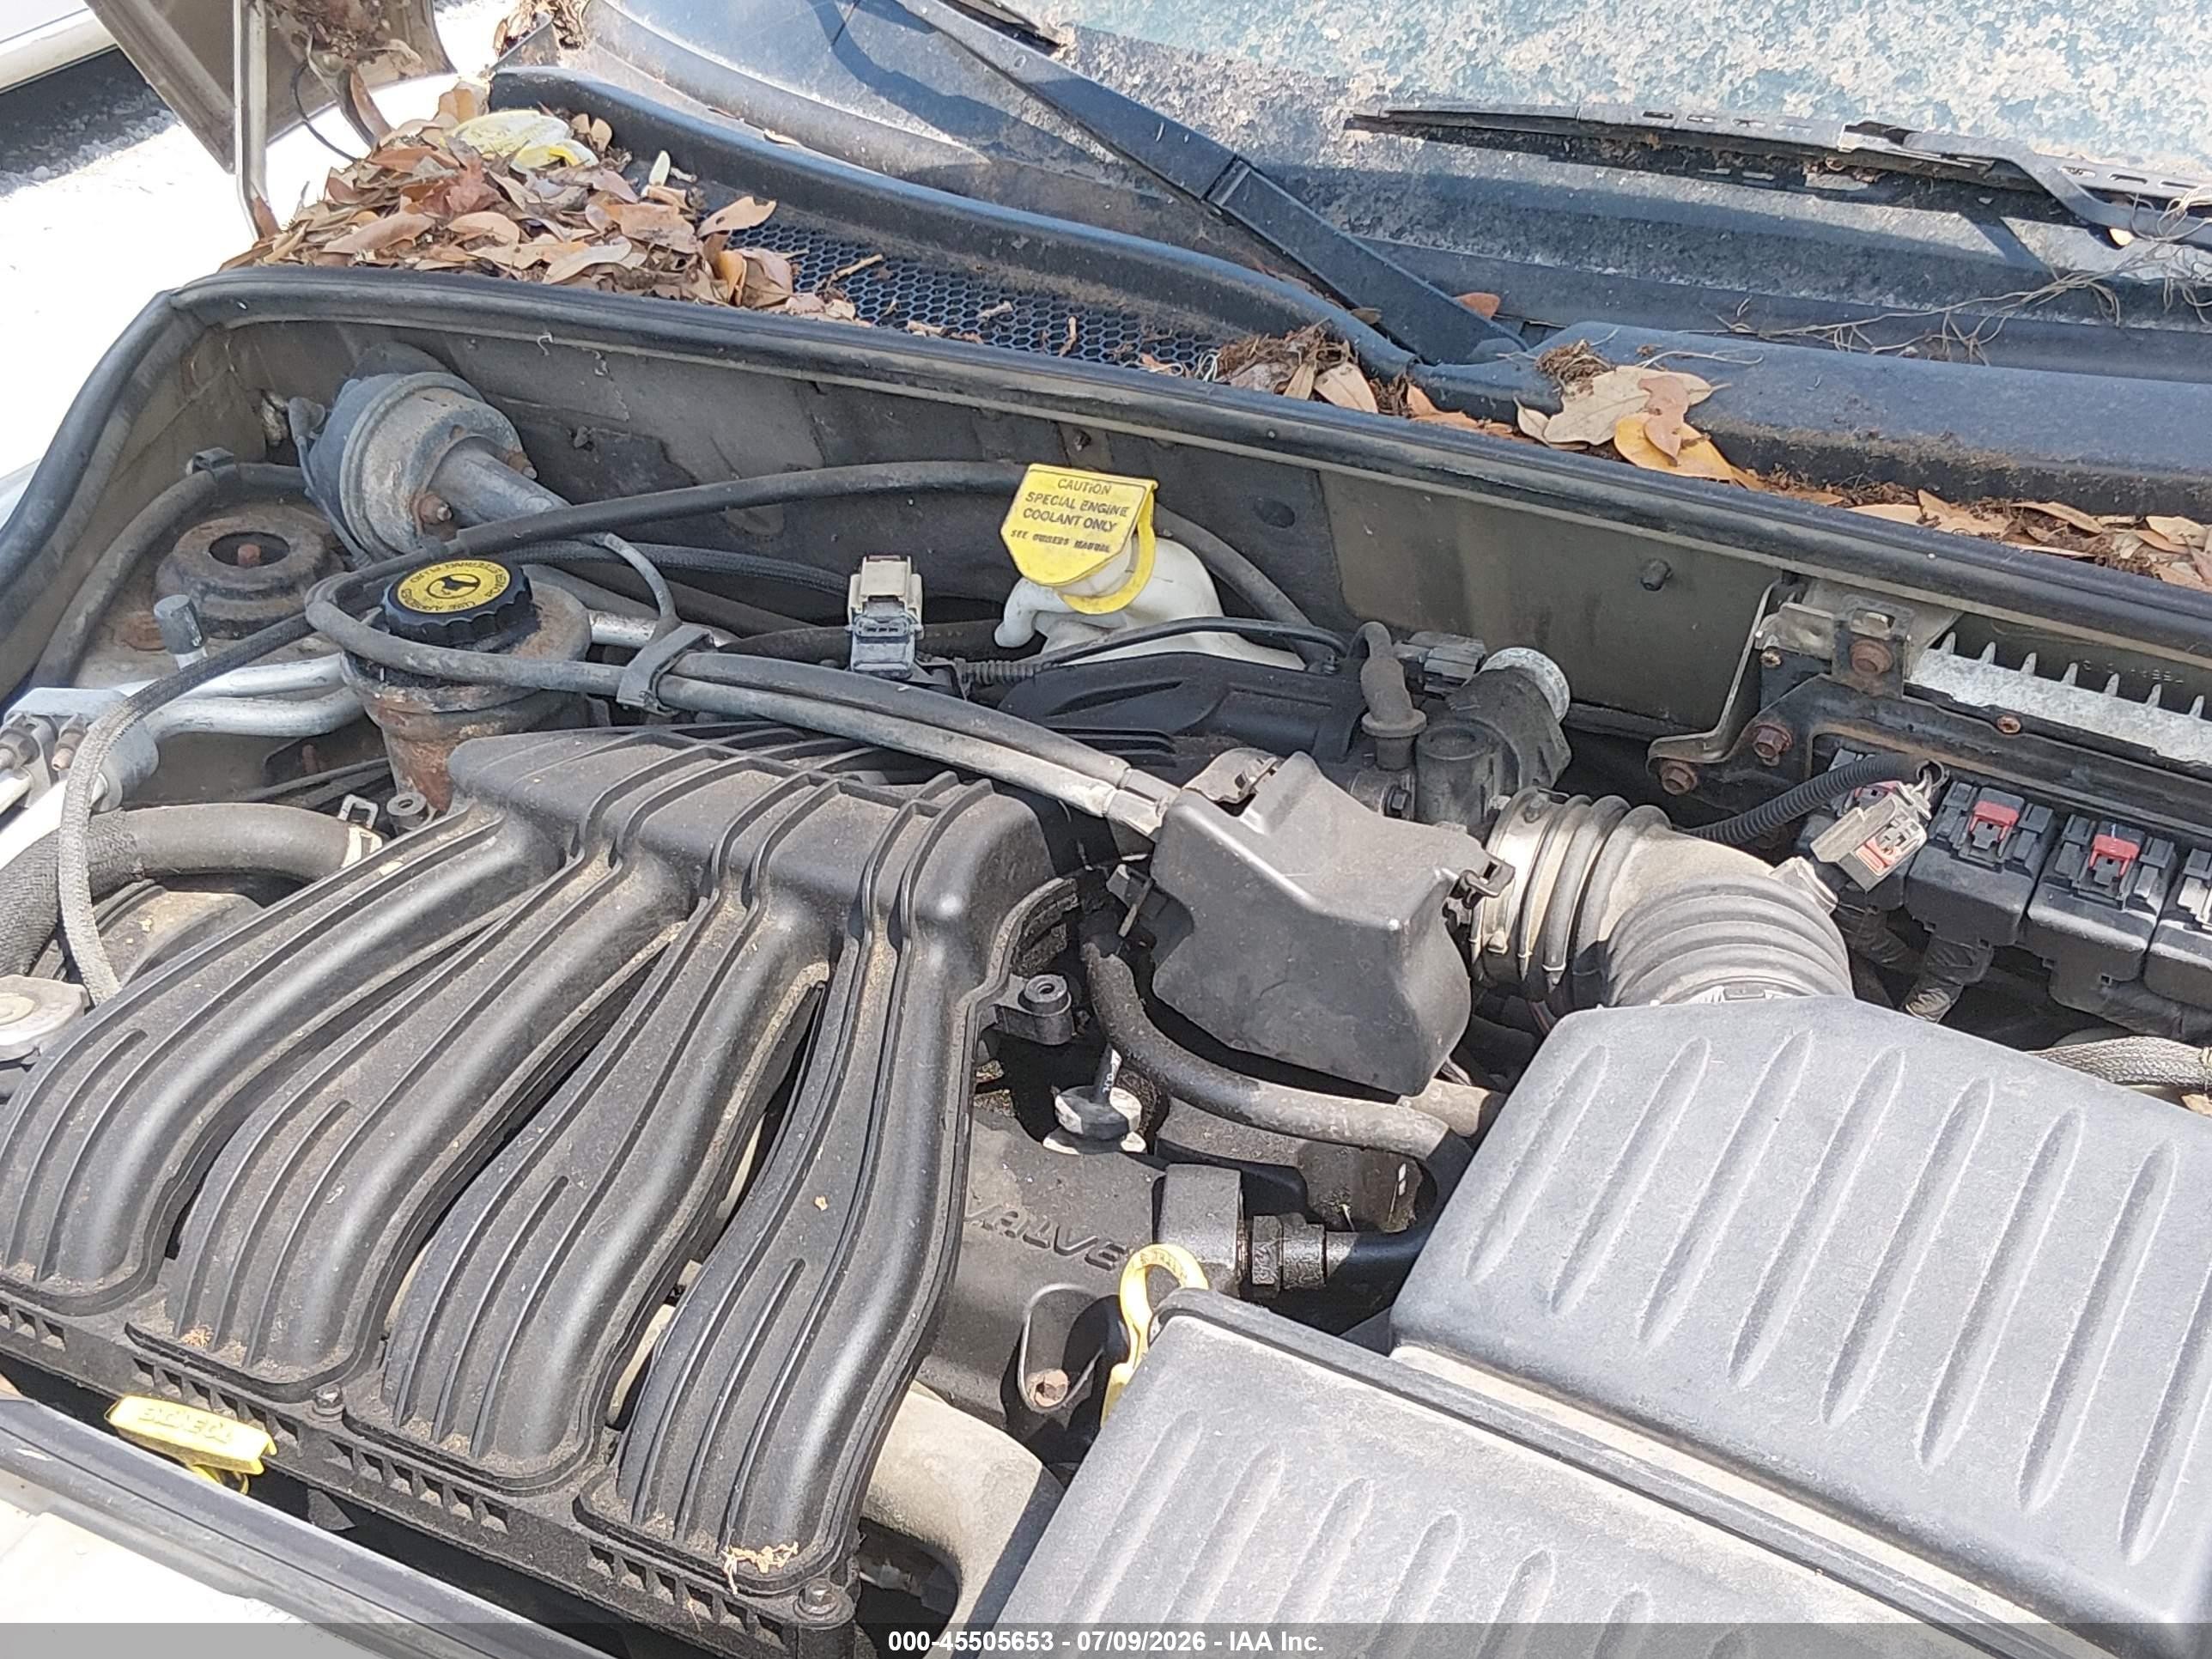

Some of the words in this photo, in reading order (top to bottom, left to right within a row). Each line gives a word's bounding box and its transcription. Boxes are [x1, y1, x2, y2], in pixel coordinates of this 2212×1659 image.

[1025, 491, 1077, 509] SPECIAL
[1079, 500, 1131, 518] ENGINE
[1023, 507, 1084, 526] COOLANT
[1084, 517, 1118, 532] ONLY
[1010, 529, 1029, 539] SEE
